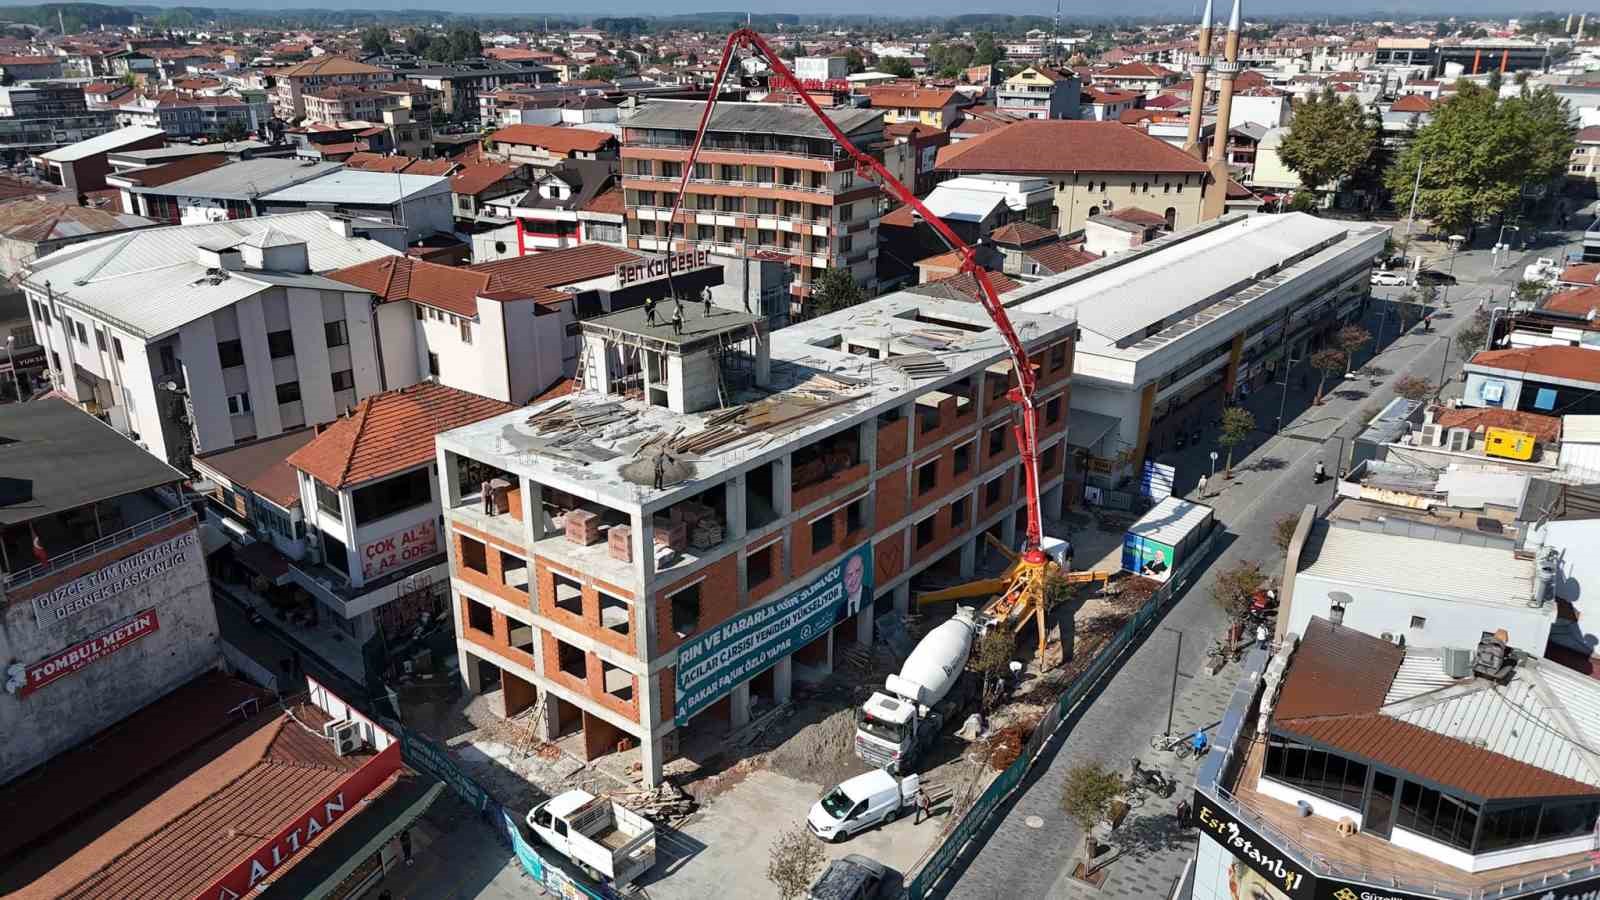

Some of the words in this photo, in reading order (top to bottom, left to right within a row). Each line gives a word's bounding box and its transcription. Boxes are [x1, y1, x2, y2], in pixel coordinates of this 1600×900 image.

[55, 585, 112, 620] DERNEK
[31, 644, 102, 682] TOMBUL
[102, 614, 152, 650] METİN
[688, 681, 719, 706] BAKAR
[248, 791, 345, 889] ALTAN
